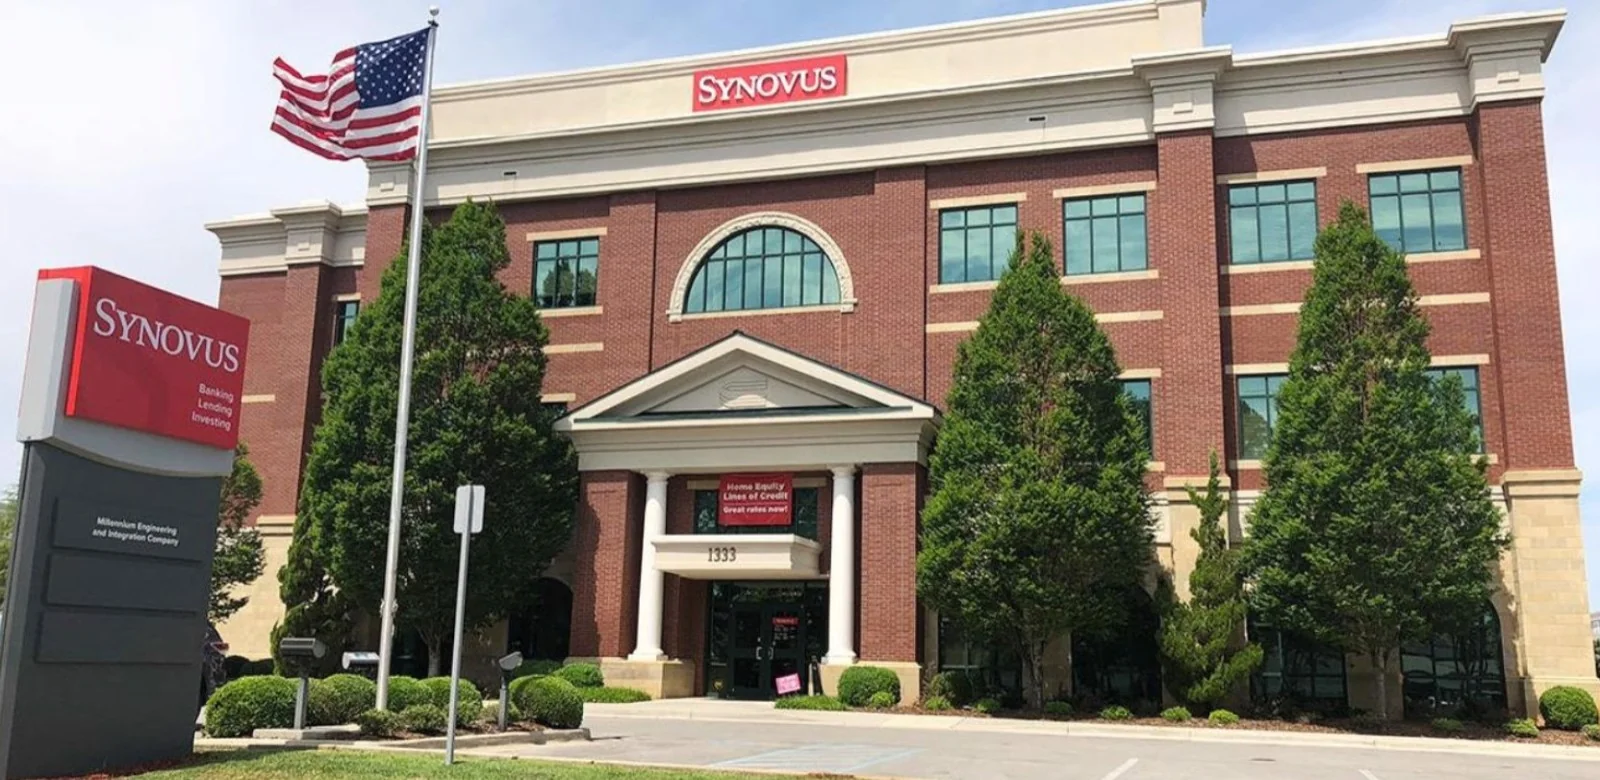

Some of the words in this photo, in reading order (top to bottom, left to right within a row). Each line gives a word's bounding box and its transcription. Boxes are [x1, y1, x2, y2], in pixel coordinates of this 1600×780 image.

[698, 66, 837, 103] SYNOVUS
[93, 298, 240, 373] SYNOVUS
[199, 383, 234, 404] Banking
[198, 397, 233, 419] Lending
[191, 410, 231, 432] Investing
[723, 492, 747, 500] Lines
[748, 492, 758, 500] of
[760, 491, 788, 500] Credit
[727, 483, 753, 491] Home
[754, 482, 785, 492] Equity
[723, 506, 745, 514] Great
[768, 505, 788, 513] now!
[97, 516, 136, 529] Millennium
[137, 522, 178, 536] Engineering
[92, 529, 107, 537] and
[107, 529, 146, 541] Integration
[147, 534, 179, 547] Company
[707, 547, 737, 562] 1333
